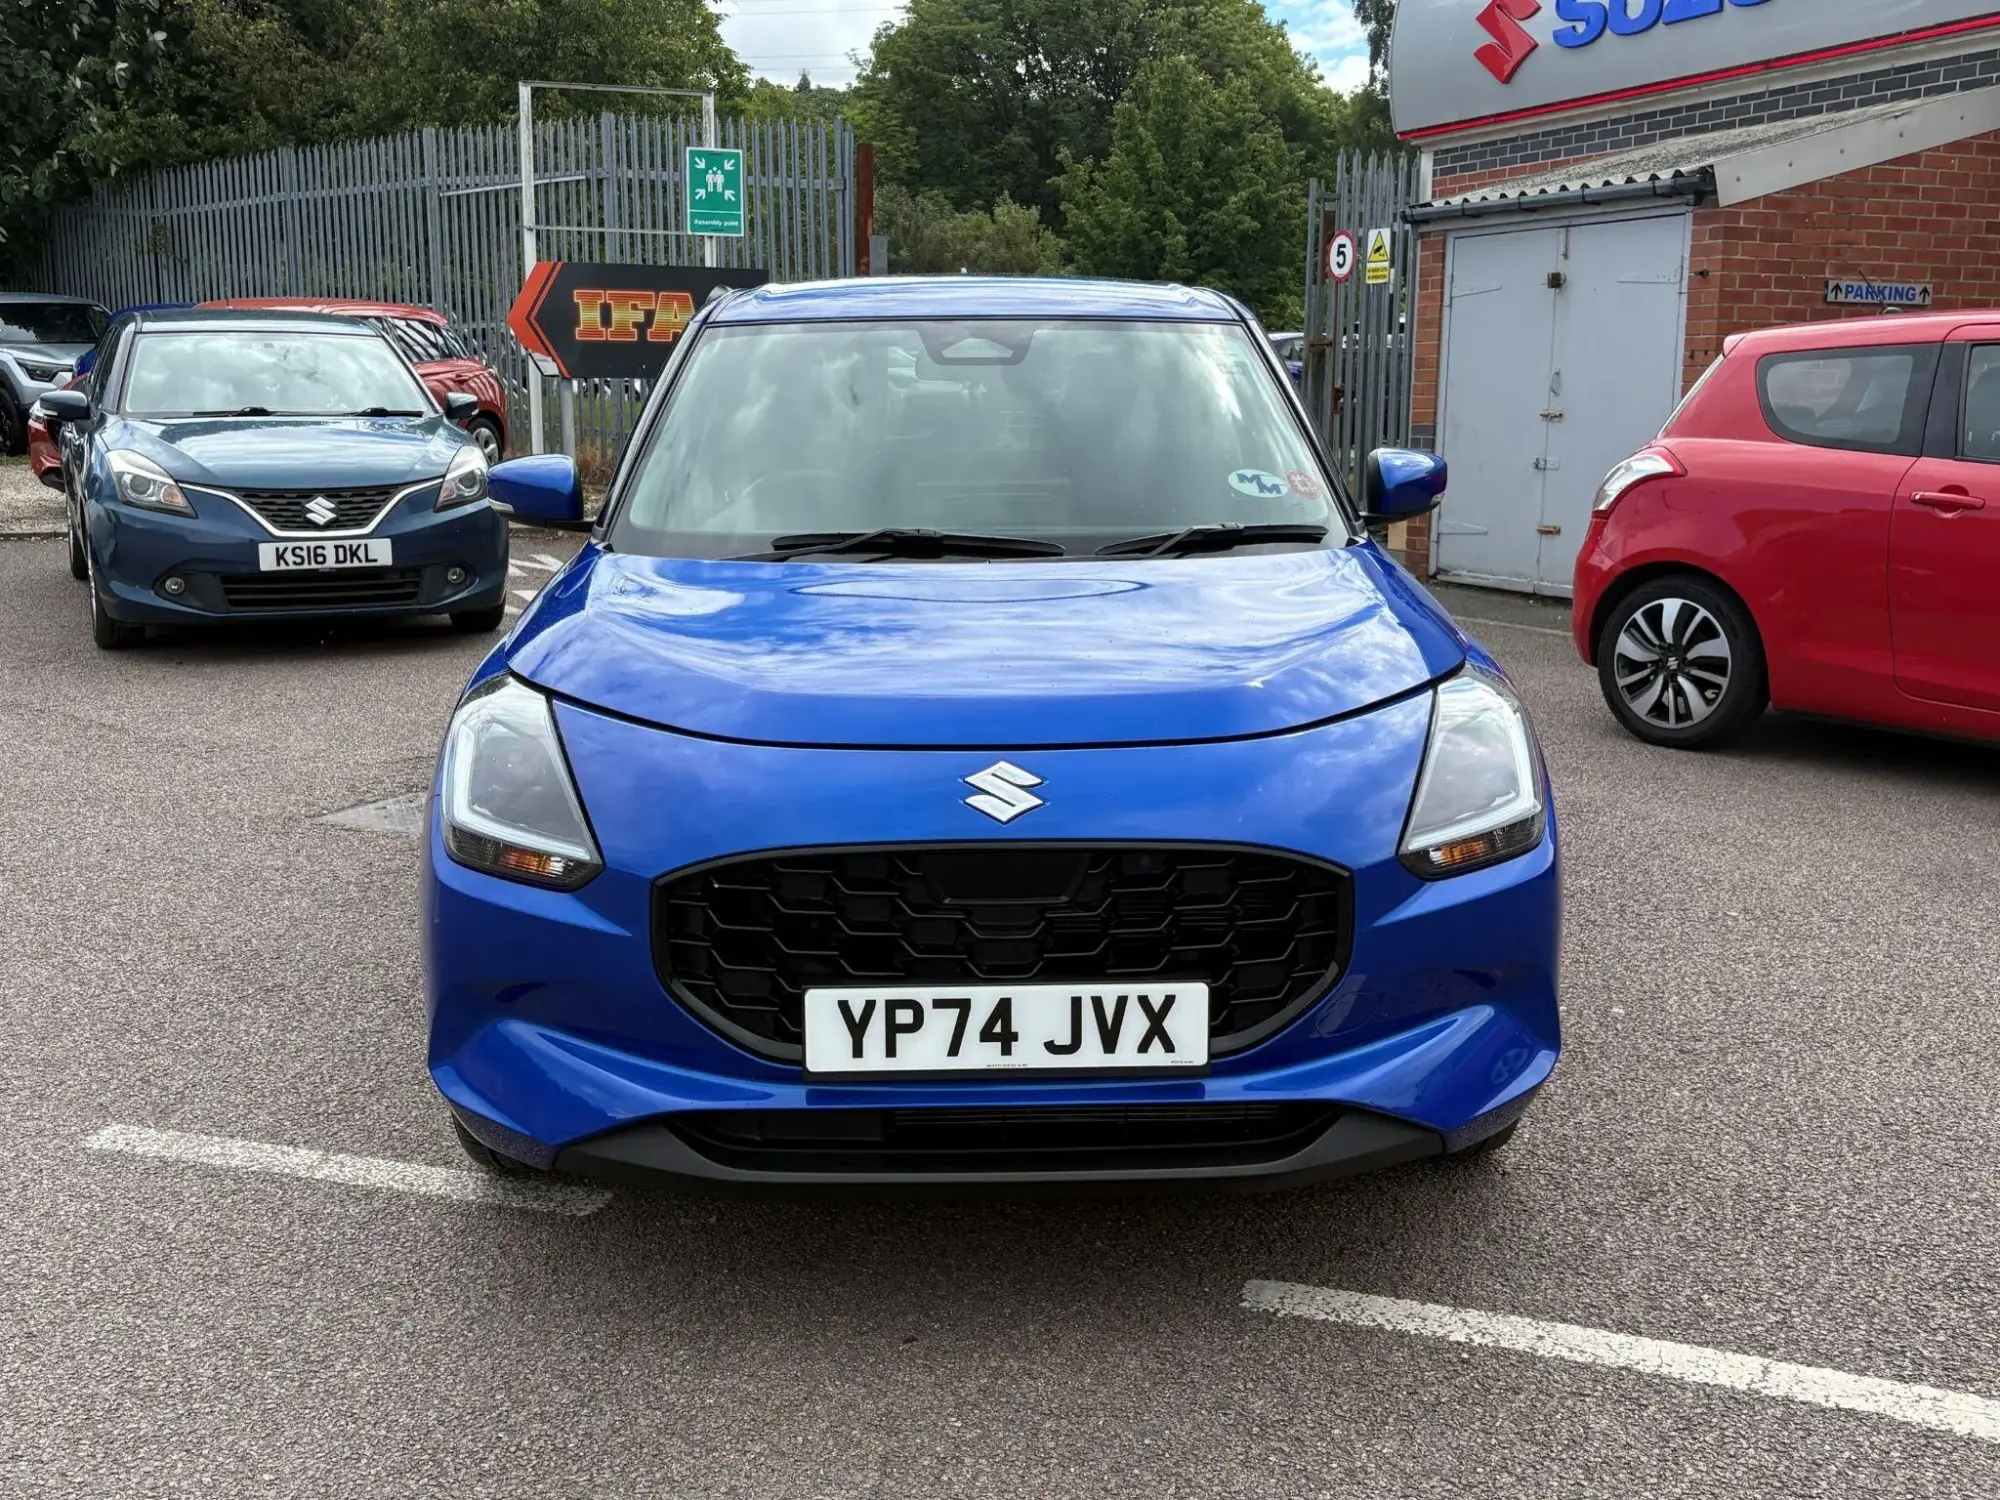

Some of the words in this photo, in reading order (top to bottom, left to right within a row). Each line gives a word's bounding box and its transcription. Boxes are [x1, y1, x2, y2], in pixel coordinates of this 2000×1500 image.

[693, 219, 722, 227] Assembly
[1336, 243, 1347, 269] 5
[1844, 284, 1917, 303] PARKING
[275, 545, 327, 567] KS16
[333, 543, 378, 564] DKL
[837, 997, 1019, 1058] YP74
[1043, 994, 1177, 1056] JVX
